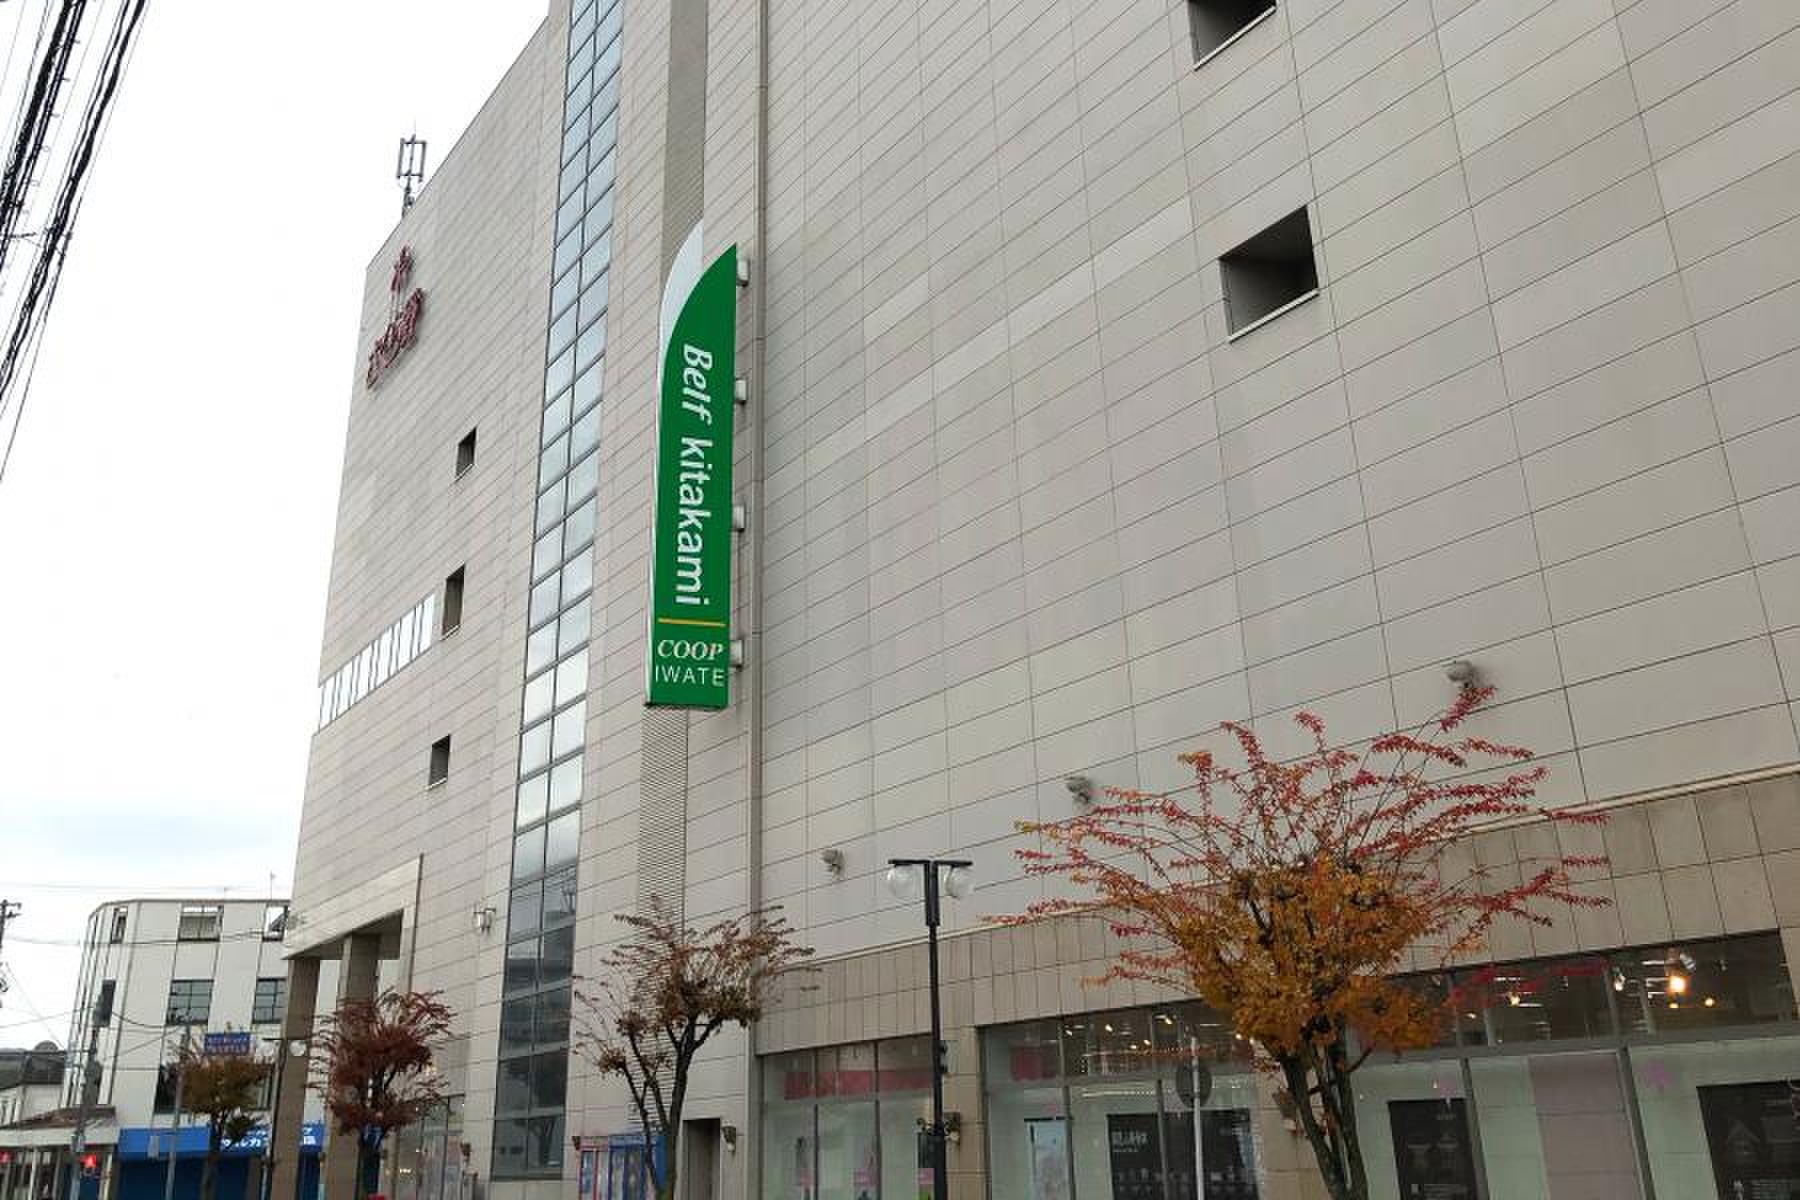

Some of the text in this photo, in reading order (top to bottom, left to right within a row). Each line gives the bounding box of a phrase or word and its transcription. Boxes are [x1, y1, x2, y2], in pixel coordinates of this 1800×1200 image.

[675, 343, 714, 606] Belf kitakami
[657, 639, 724, 661] COOP
[655, 665, 725, 687] IWATE
